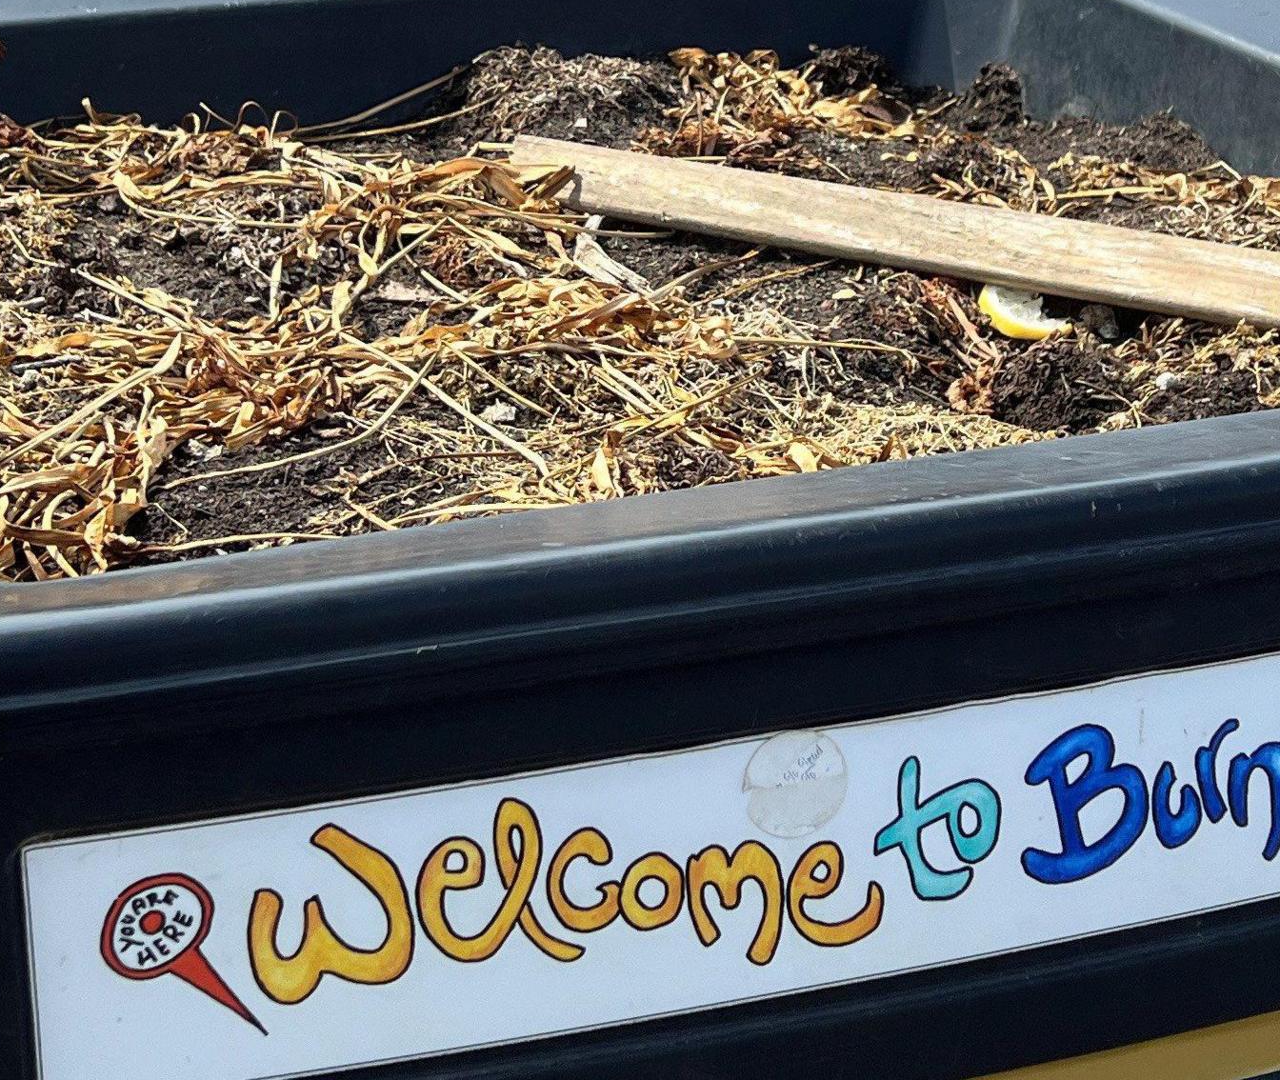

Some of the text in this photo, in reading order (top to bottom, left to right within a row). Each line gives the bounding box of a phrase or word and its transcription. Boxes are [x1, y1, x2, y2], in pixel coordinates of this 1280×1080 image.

[247, 796, 884, 1005] Welcome
[872, 754, 1004, 901] to
[118, 889, 180, 953] YOU ARE
[137, 910, 194, 966] HERE
